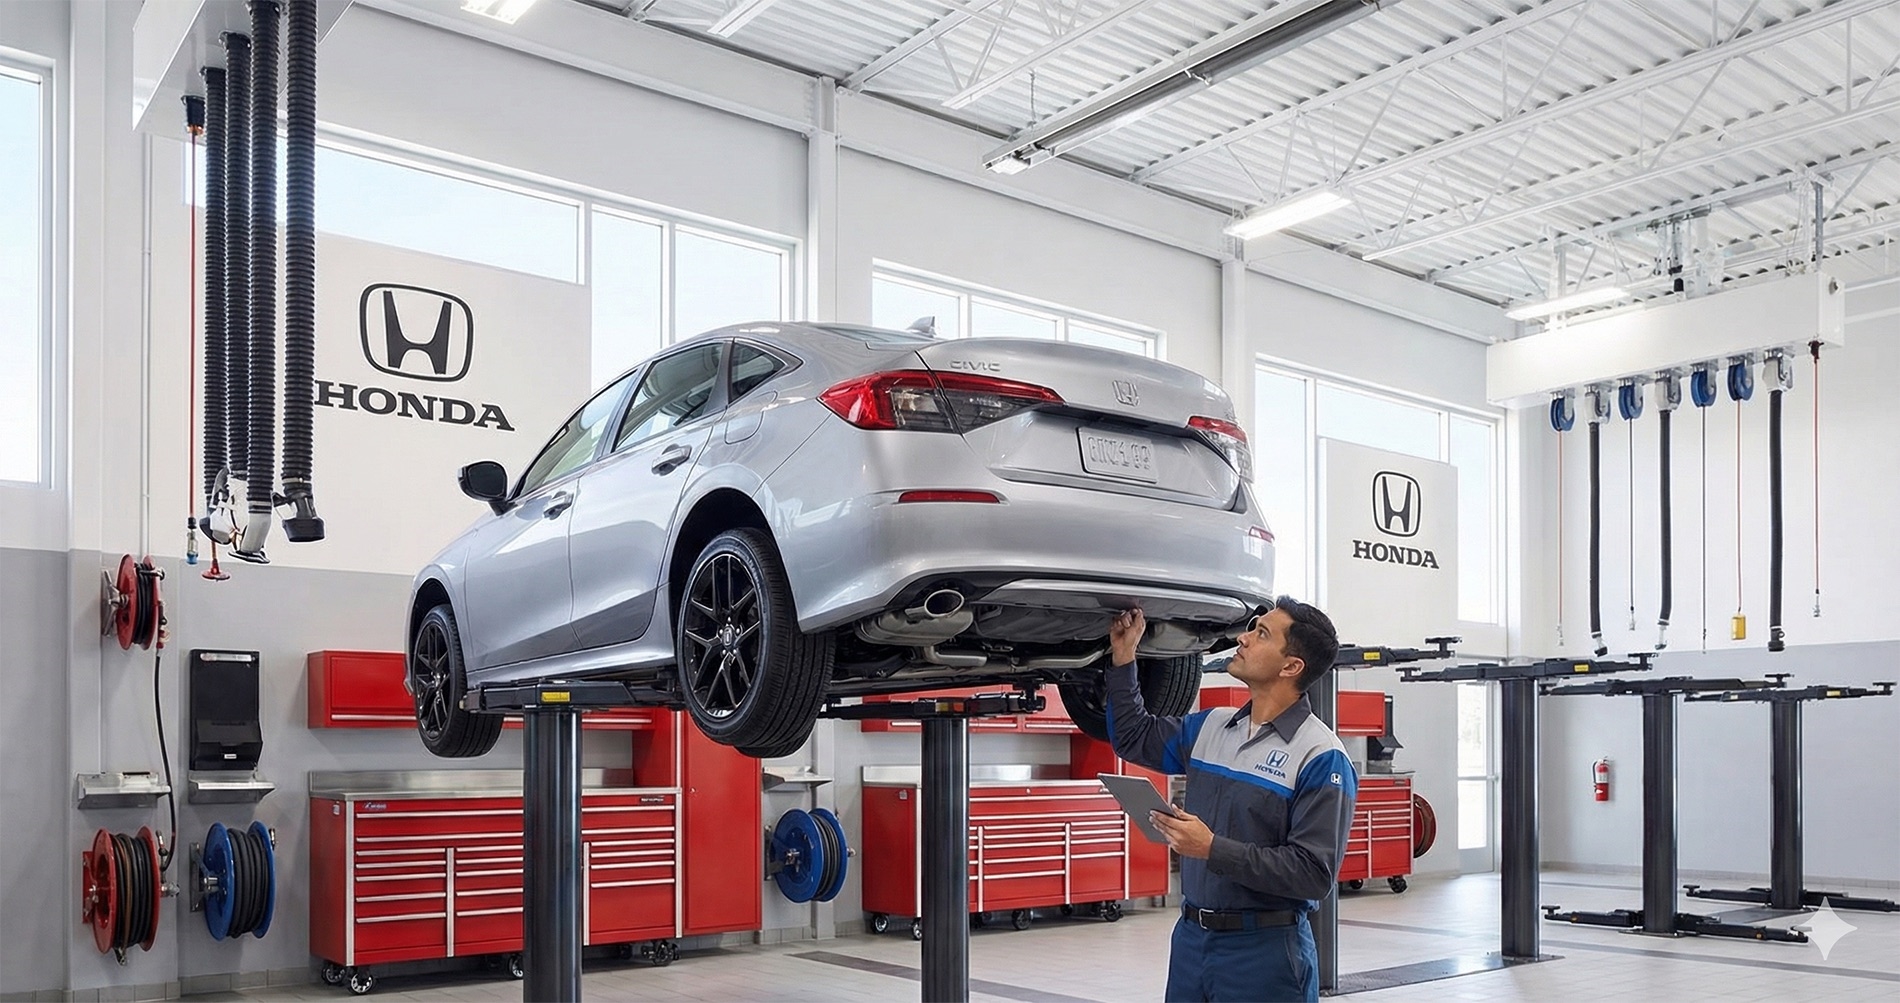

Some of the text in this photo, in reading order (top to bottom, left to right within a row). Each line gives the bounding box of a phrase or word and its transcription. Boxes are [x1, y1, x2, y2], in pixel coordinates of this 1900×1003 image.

[949, 360, 1001, 372] CIVIC
[314, 379, 516, 432] HONDA
[1352, 539, 1440, 570] HONDA
